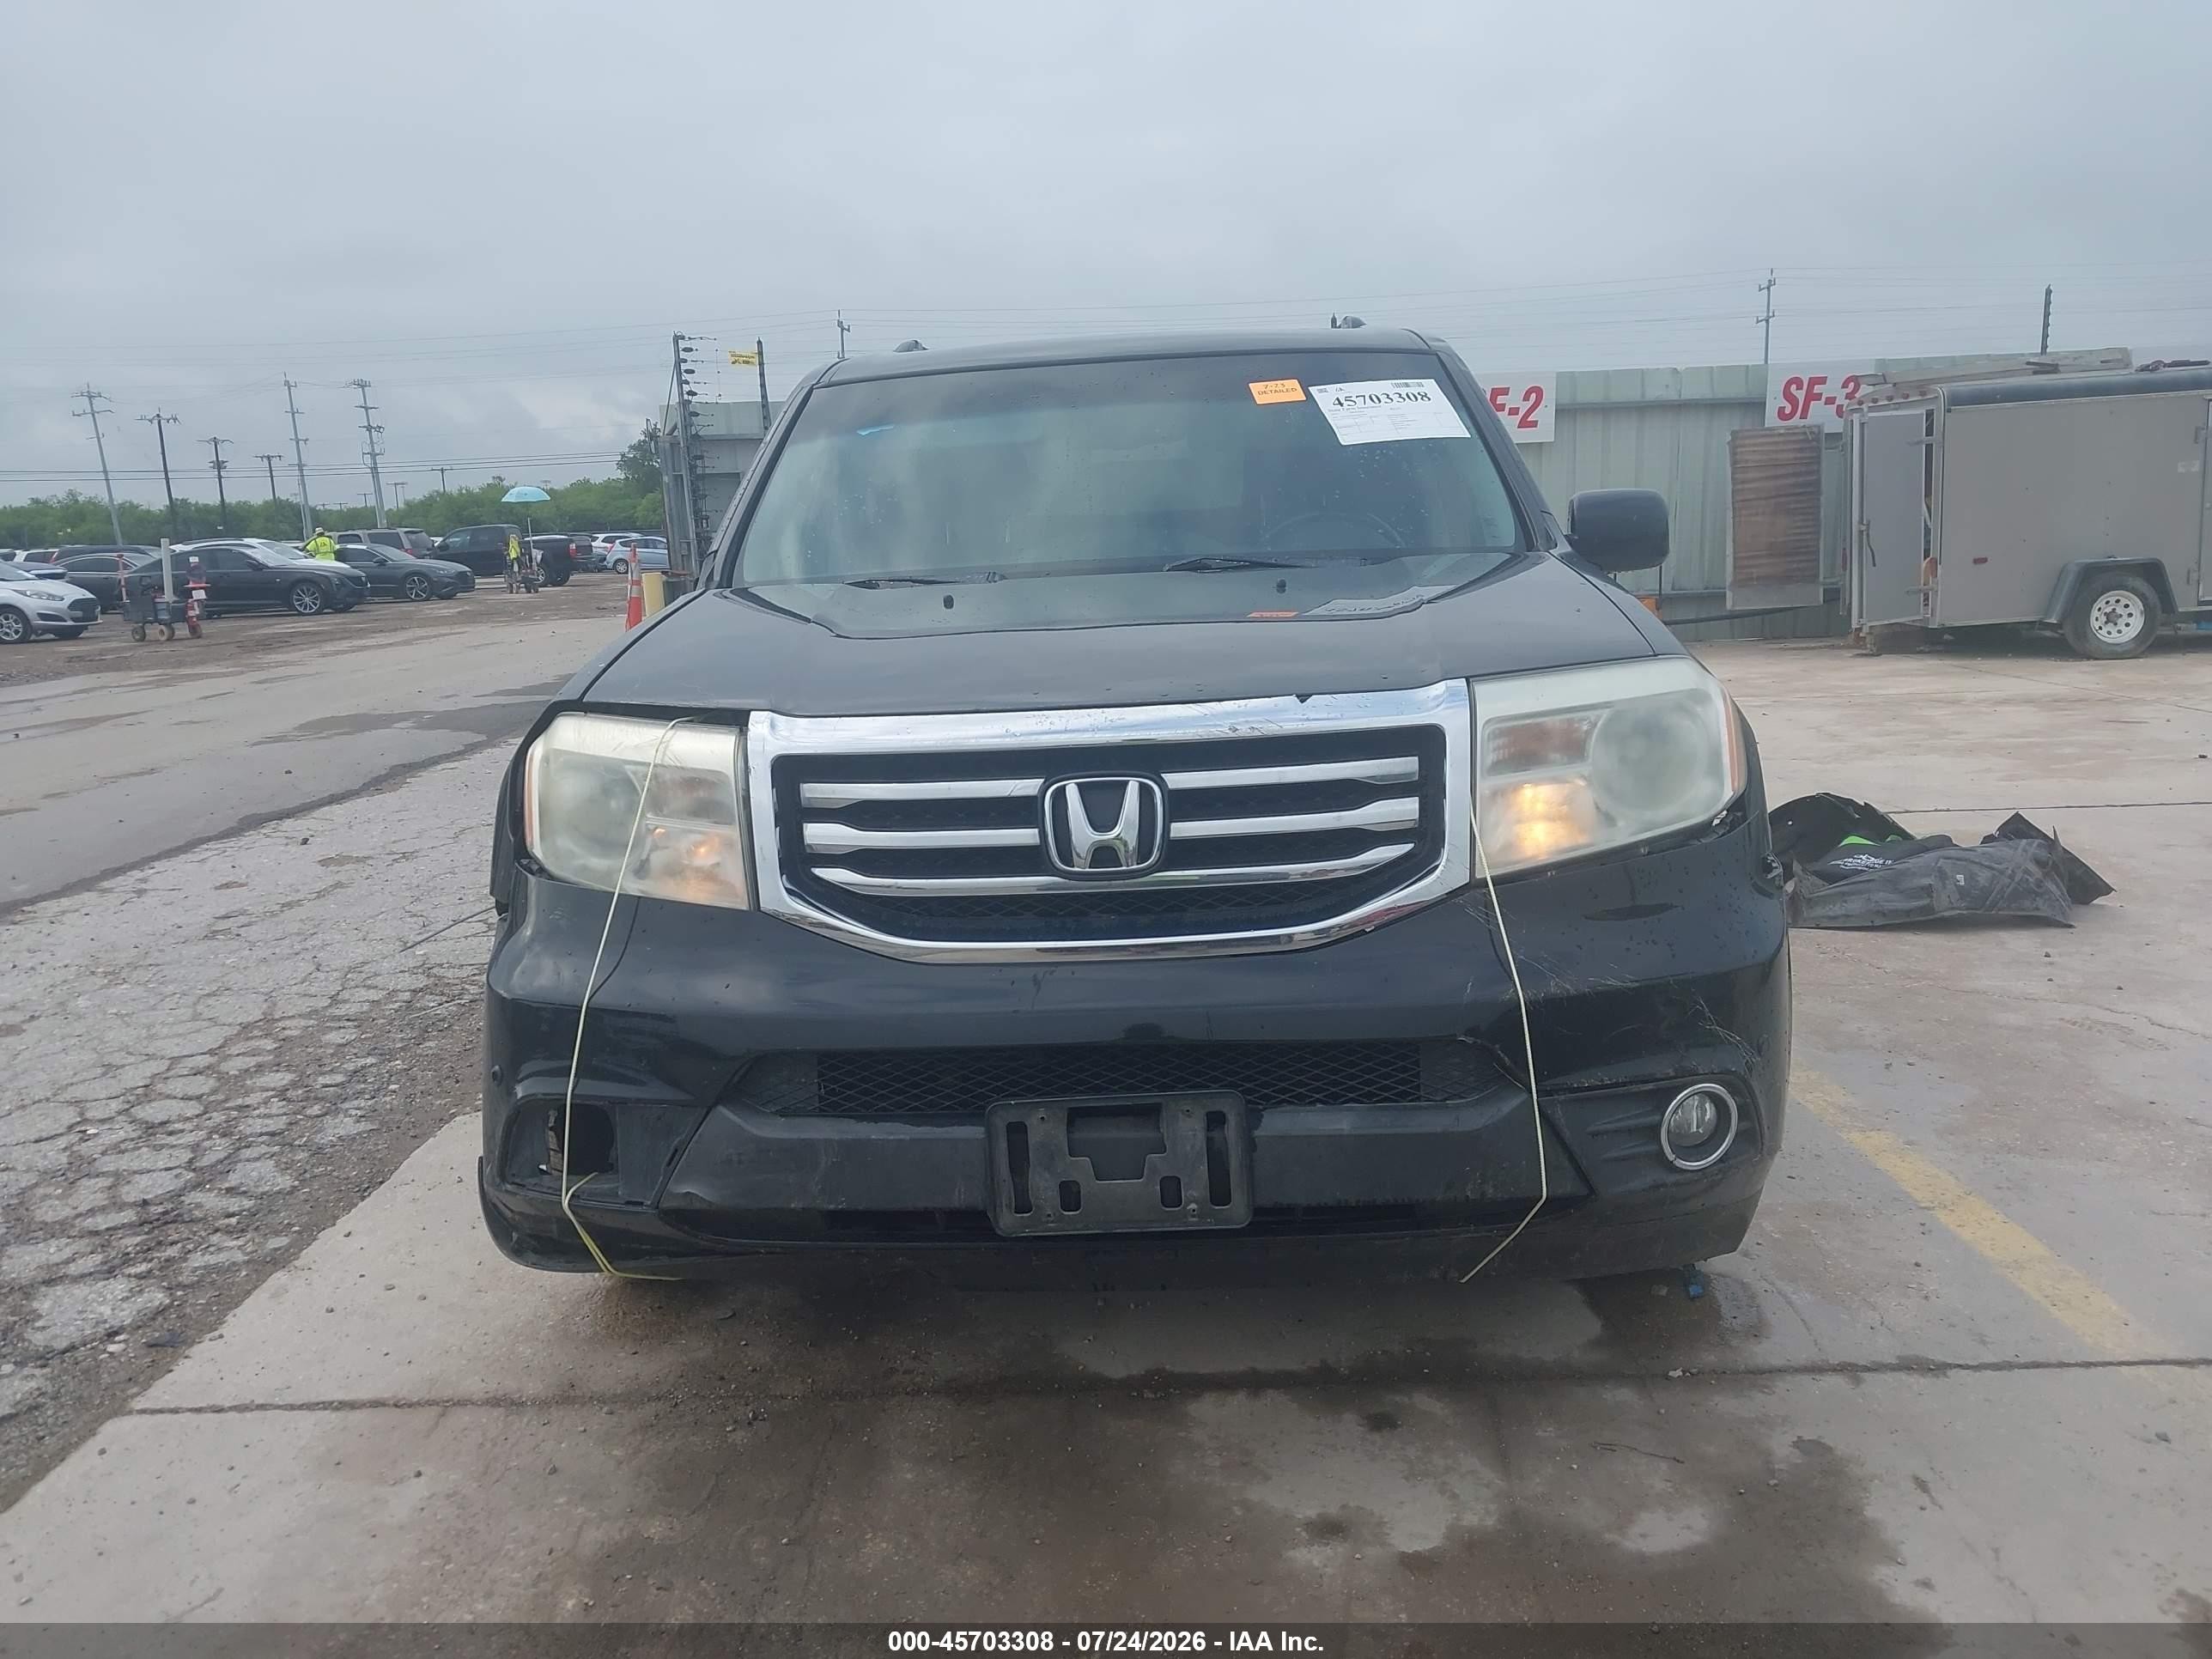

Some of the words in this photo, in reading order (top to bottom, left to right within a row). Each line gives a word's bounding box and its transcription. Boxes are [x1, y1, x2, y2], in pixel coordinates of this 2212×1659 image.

[1257, 387, 1297, 396] DETAILED
[1332, 391, 1431, 407] 45703308
[1777, 375, 1861, 422] SF-3
[1489, 386, 1543, 428] F-2
